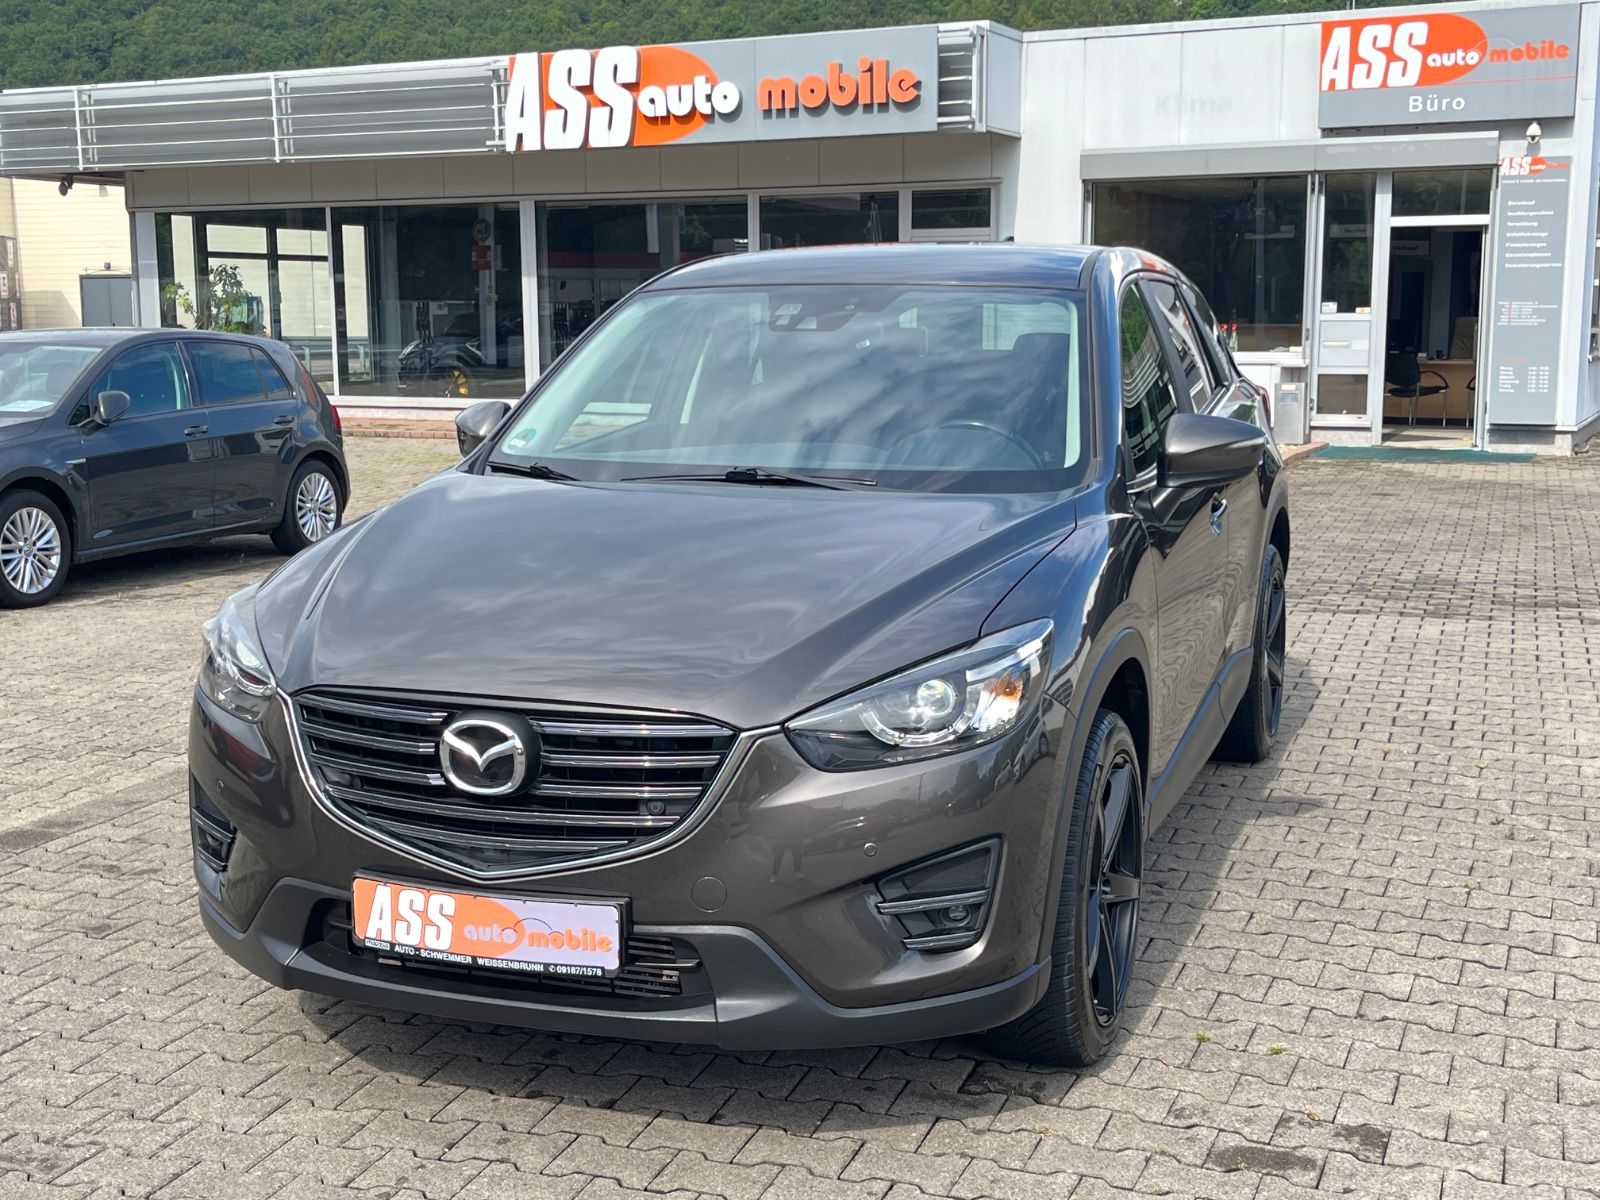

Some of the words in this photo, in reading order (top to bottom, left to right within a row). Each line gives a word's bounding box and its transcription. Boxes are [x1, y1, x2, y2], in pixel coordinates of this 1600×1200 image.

[1321, 21, 1429, 91] ASS
[1426, 48, 1481, 68] auto
[1488, 40, 1570, 64] mobile
[505, 45, 641, 152] ASS
[637, 75, 740, 118] auto
[757, 56, 921, 111] mobile
[1408, 94, 1466, 113] Büro
[1500, 156, 1532, 176] ASS
[365, 883, 456, 950] ASS
[463, 922, 519, 944] auto
[527, 927, 612, 953] mobile
[394, 944, 414, 956] AUTO
[420, 948, 472, 964] SCHWEMMER
[476, 957, 544, 972] WEISSENBRUNN
